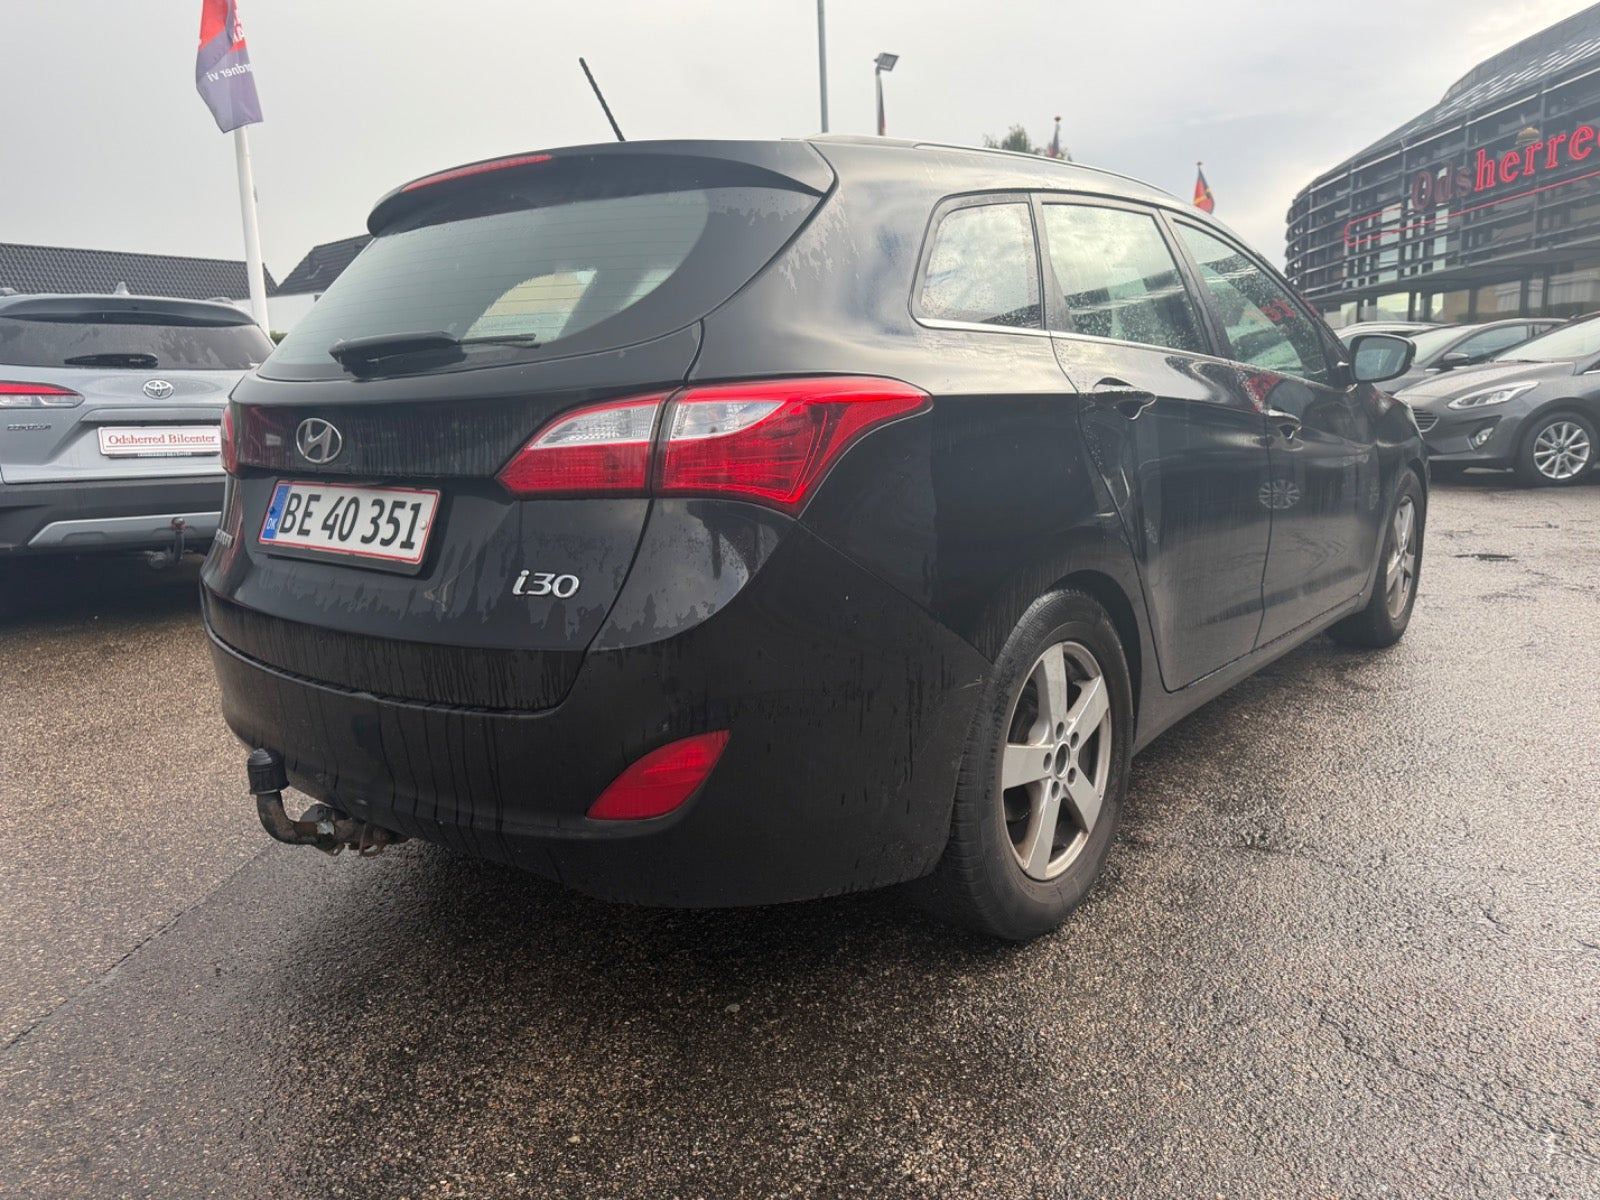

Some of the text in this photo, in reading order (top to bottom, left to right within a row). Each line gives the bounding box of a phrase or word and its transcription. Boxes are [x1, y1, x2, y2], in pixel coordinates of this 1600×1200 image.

[1411, 125, 1600, 211] Odsherre
[108, 433, 216, 445] Odsherred Bilcenter
[266, 517, 279, 531] DK
[278, 493, 422, 550] BE 40 351
[512, 569, 580, 598] i30
